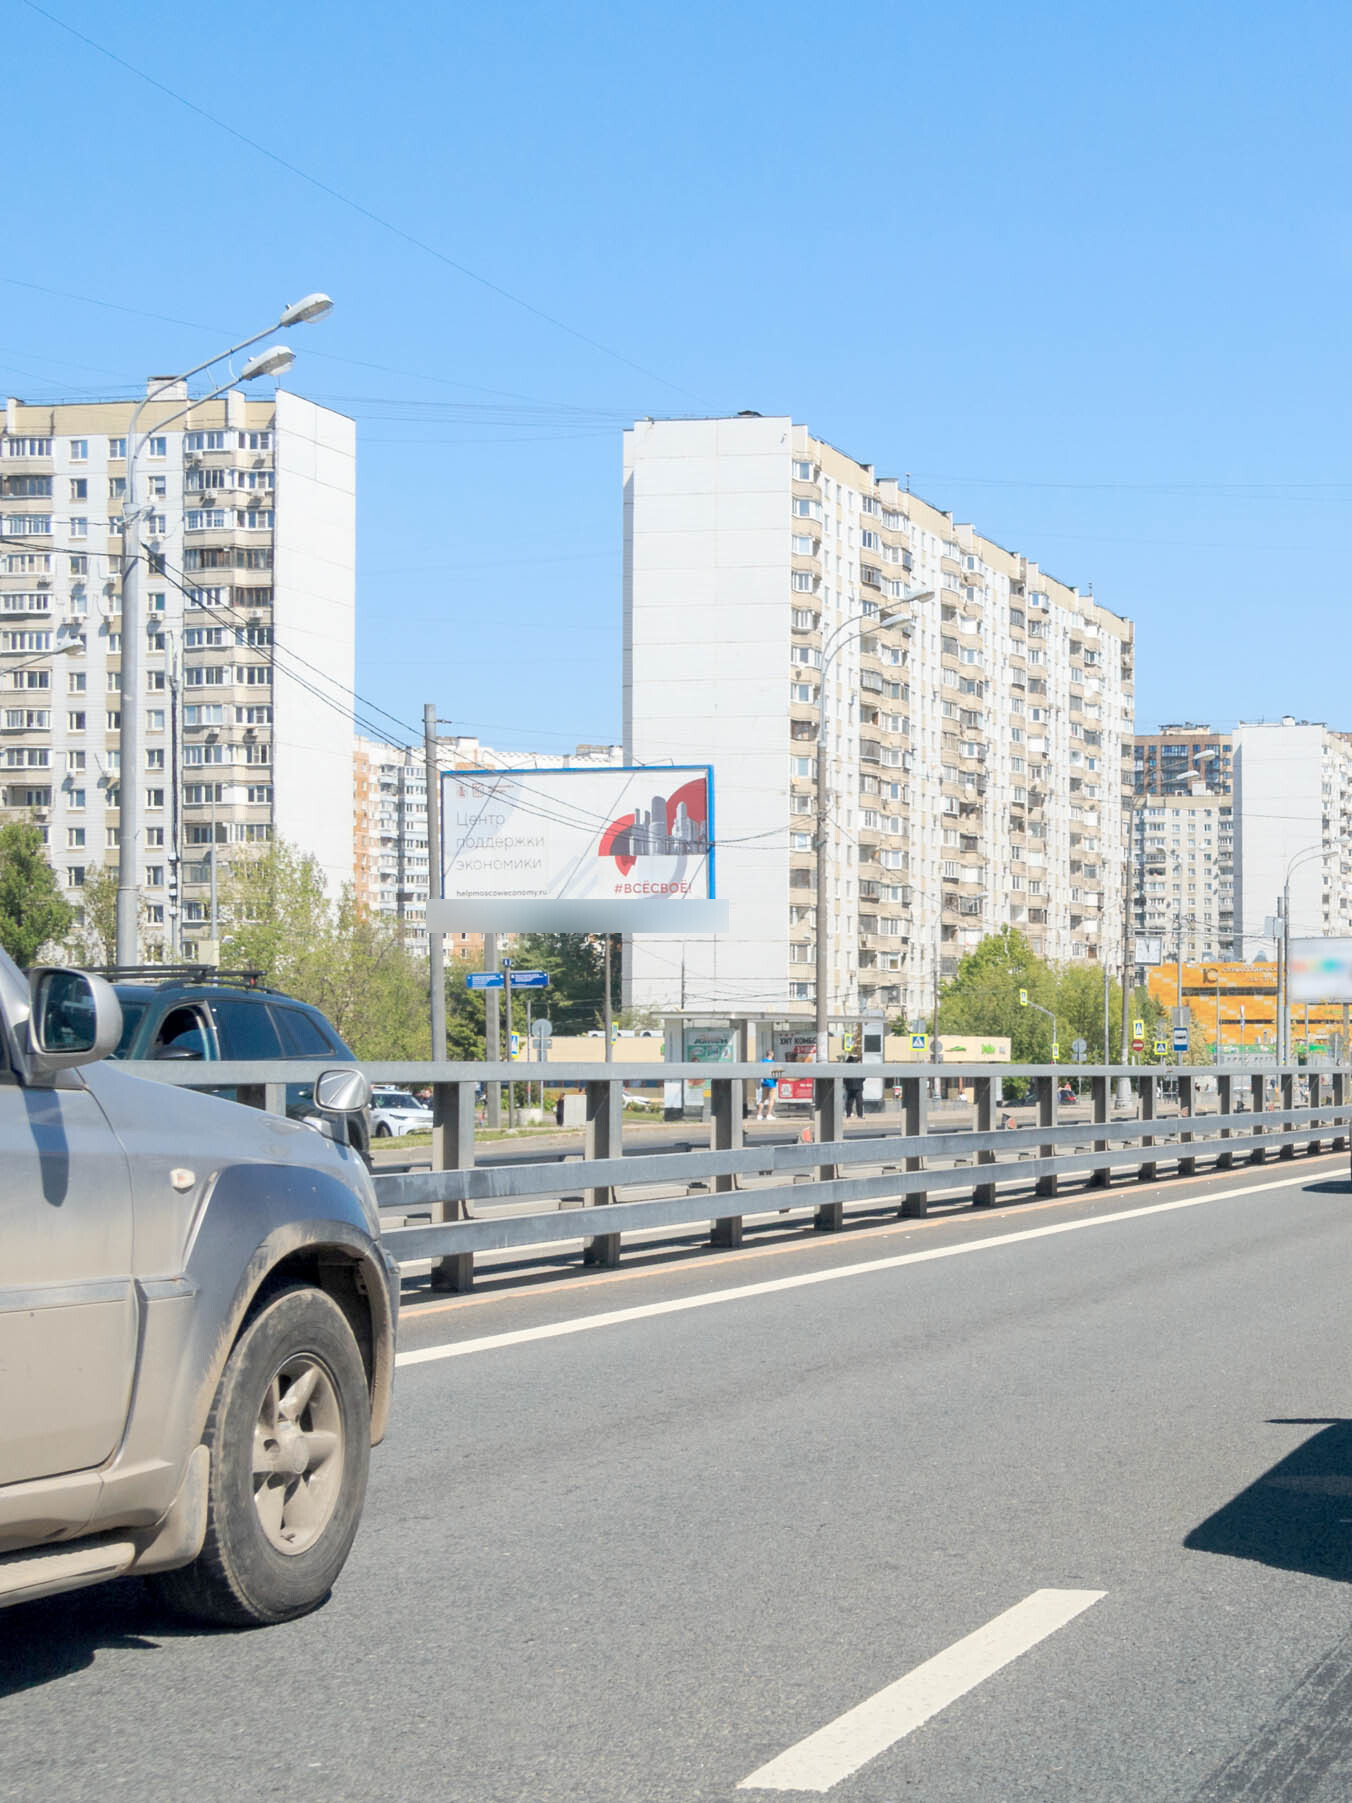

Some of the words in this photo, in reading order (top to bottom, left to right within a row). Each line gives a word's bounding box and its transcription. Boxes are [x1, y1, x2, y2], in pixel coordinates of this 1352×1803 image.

[456, 811, 506, 829] Центр
[456, 836, 545, 852] поддержки
[456, 859, 543, 871] экономики
[456, 888, 548, 898] helpmoscoweconomy.ru
[613, 880, 693, 894] #ВСЁСВОЁ!
